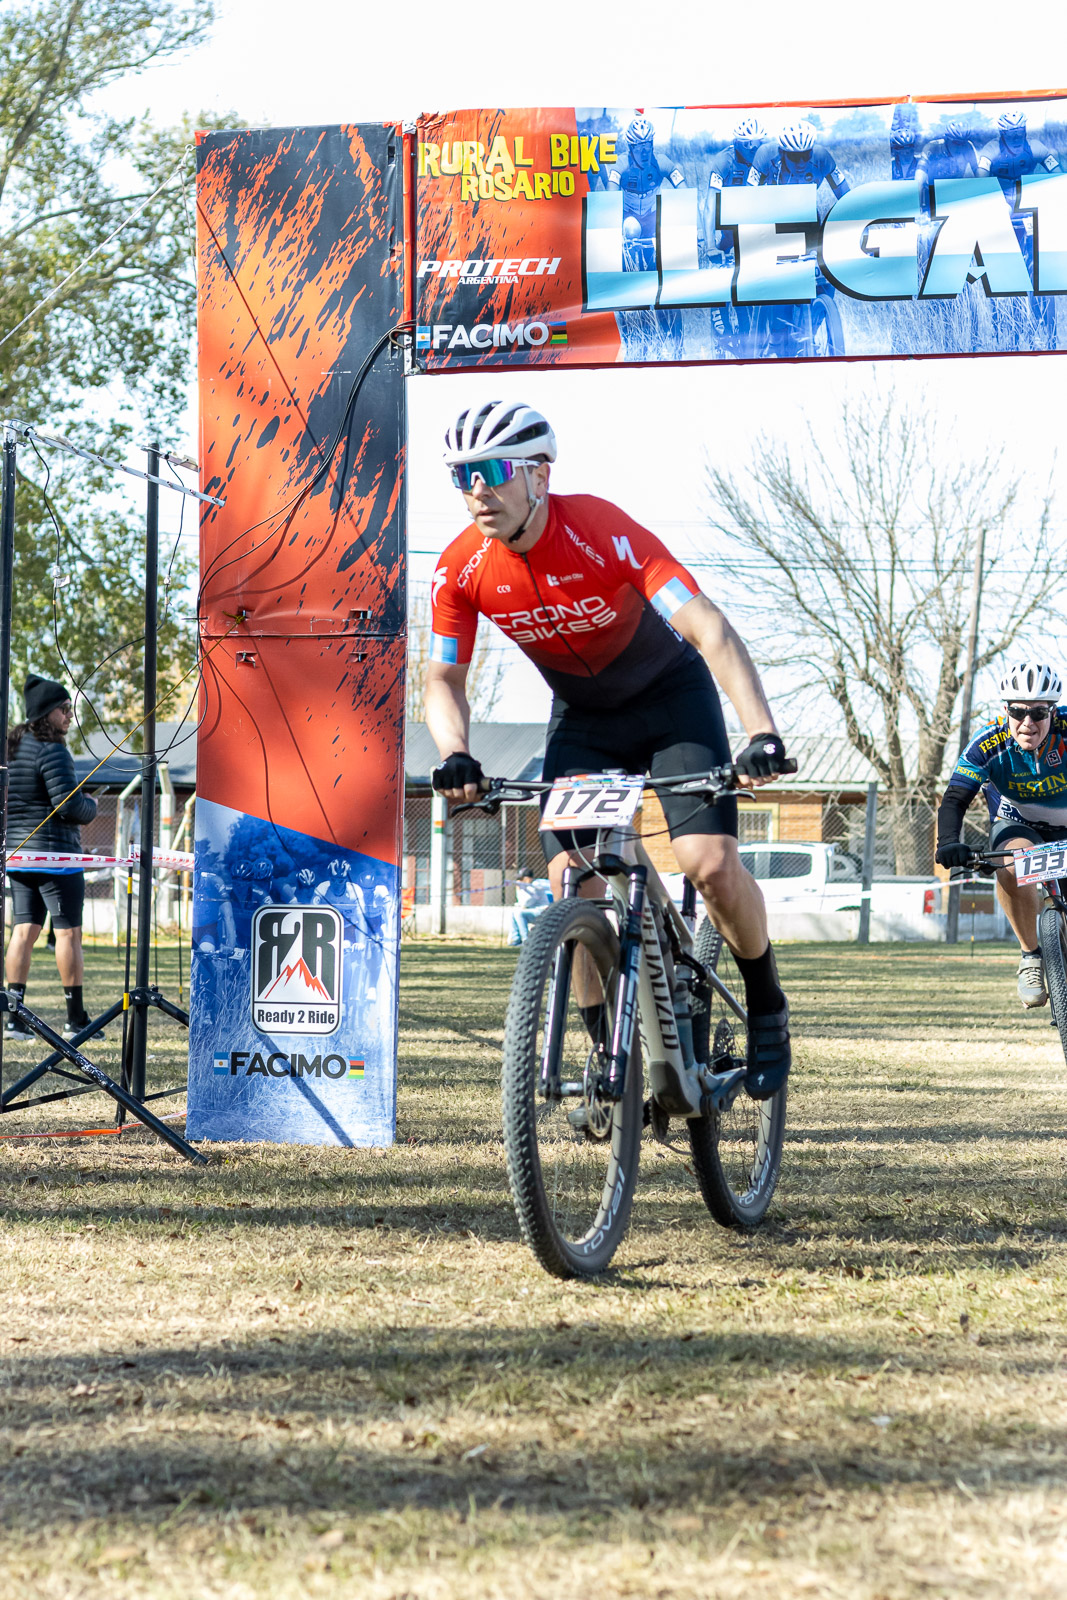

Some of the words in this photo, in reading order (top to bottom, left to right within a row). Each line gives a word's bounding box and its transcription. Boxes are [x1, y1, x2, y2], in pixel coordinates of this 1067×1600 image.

[418, 136, 534, 177] RURAL
[550, 134, 619, 174] BIKE
[461, 170, 575, 202] ROSARIO
[416, 257, 562, 278] PROTECH
[457, 275, 519, 285] ARGENTINA
[432, 321, 549, 349] FACIMO
[490, 596, 606, 629] CRONO
[511, 607, 617, 643] BIKES
[979, 727, 1012, 754] FESTINA
[956, 765, 984, 783] FESTINA
[554, 789, 631, 816] 172
[1022, 850, 1065, 876] 133
[257, 1009, 295, 1024] Ready
[297, 1010, 305, 1024] 2
[308, 1010, 335, 1024] Ride
[230, 1051, 347, 1079] FACIMO
